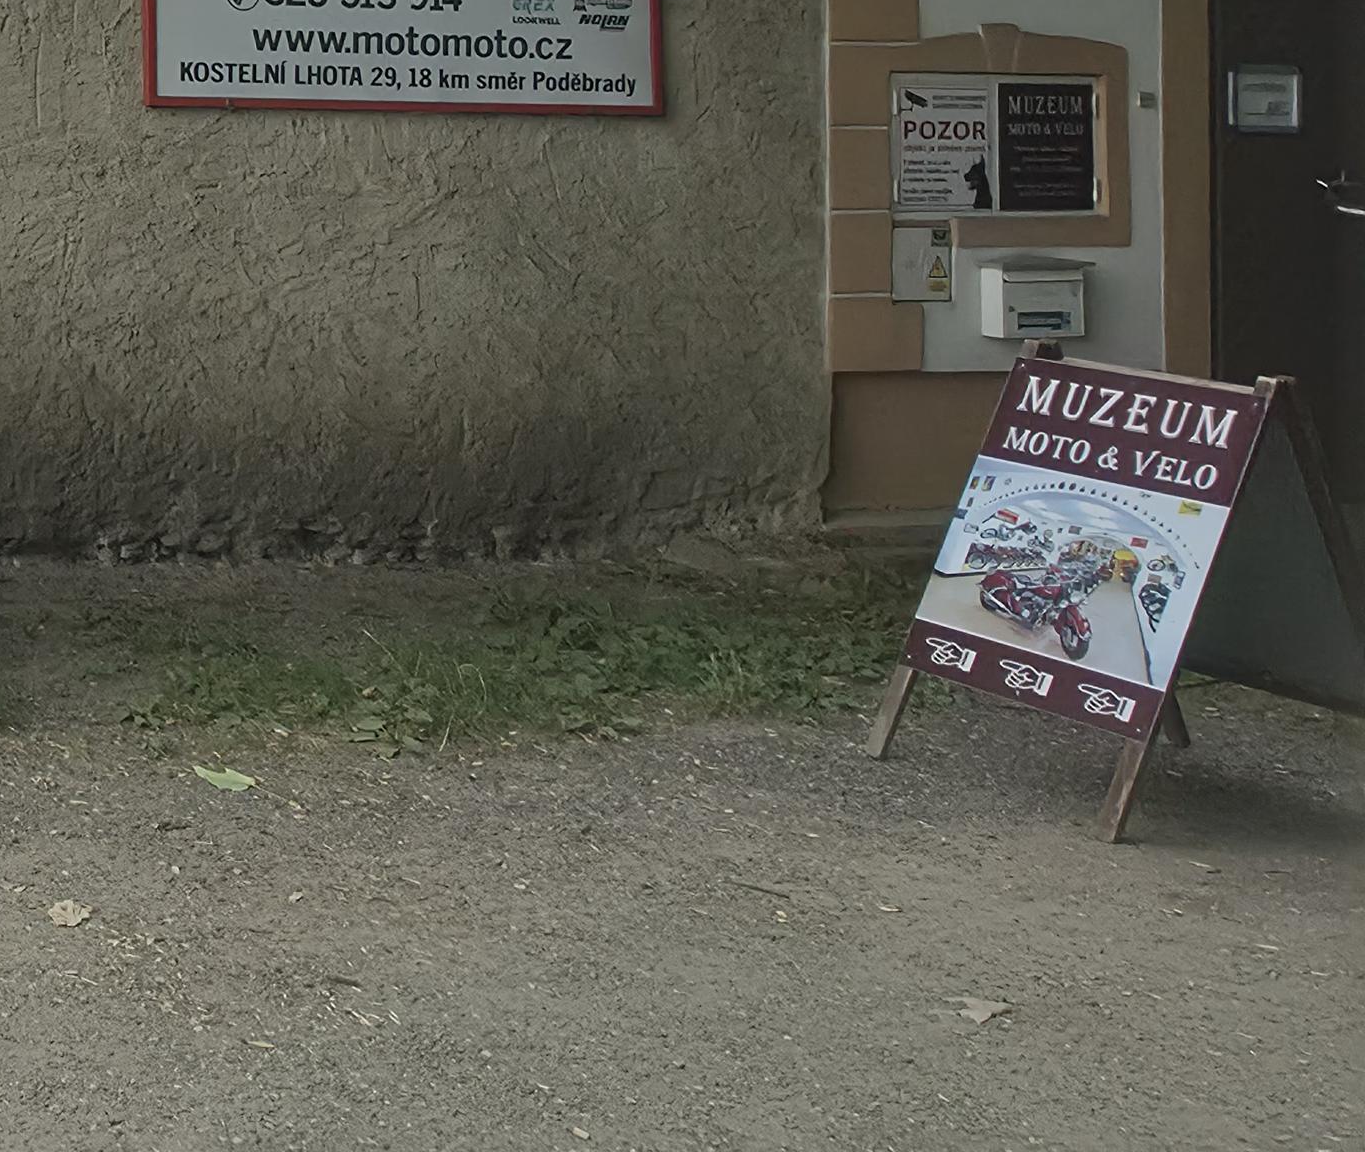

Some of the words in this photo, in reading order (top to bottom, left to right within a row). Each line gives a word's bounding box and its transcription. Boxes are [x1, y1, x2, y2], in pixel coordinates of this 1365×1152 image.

[579, 14, 630, 31] NOLAN
[253, 26, 573, 60] www.motomoto.cz
[180, 60, 287, 84] KOSTELNÍ
[294, 65, 363, 86] LHOTA
[370, 67, 402, 90] 29,
[408, 68, 432, 88] 18
[439, 69, 469, 89] km
[477, 71, 526, 90] směr
[533, 71, 636, 97] Poděbrady
[1008, 96, 1082, 114] MUZEUM
[903, 120, 986, 140] POZOR
[1016, 375, 1239, 449] MUZEUM
[1002, 426, 1091, 464] MOTO
[1097, 445, 1119, 471] &
[1134, 450, 1218, 490] VELO
